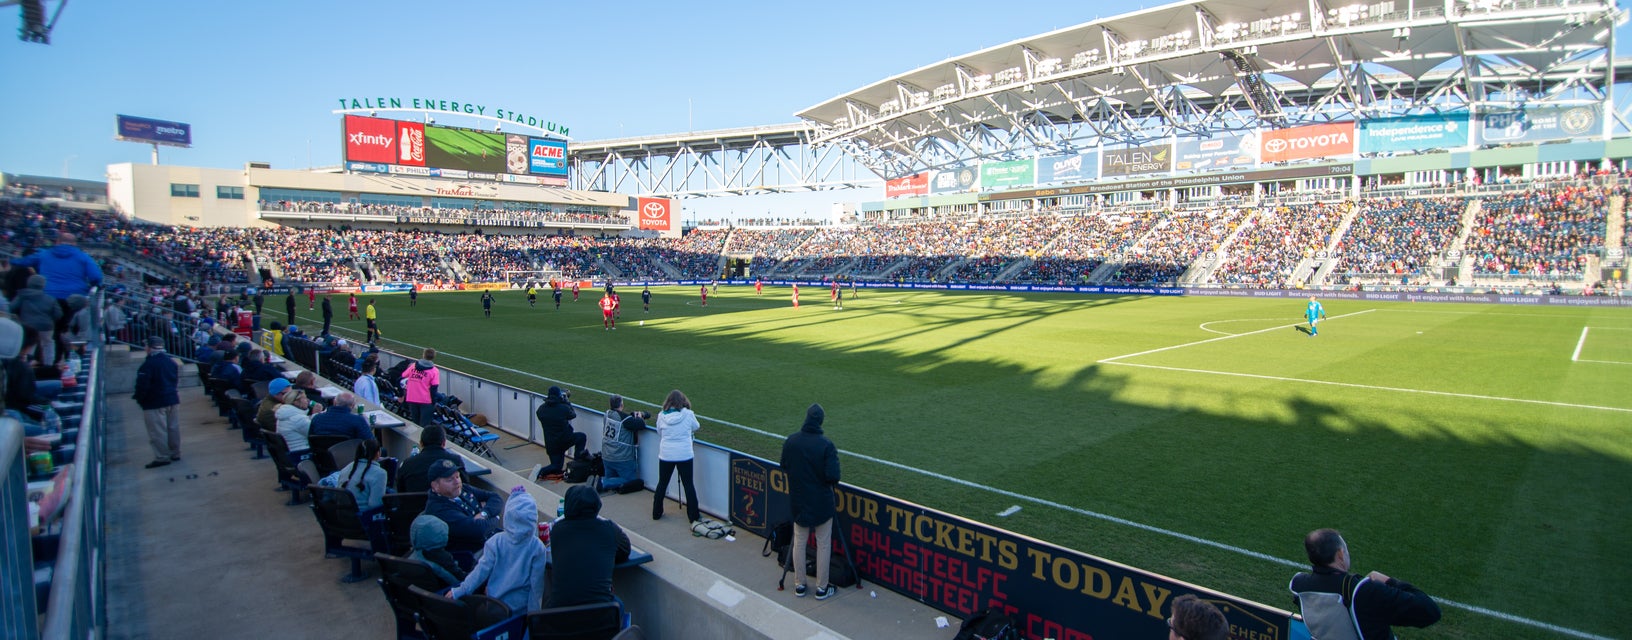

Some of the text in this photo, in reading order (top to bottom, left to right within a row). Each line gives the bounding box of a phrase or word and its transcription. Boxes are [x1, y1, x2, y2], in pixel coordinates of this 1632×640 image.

[339, 98, 569, 136] TALEN ENERGY STADIUM
[1370, 124, 1443, 136] Independence
[350, 132, 392, 148] xfinity
[1288, 133, 1348, 149] TOYOTA
[534, 146, 562, 157] ACME
[1106, 152, 1152, 166] TALEN
[1132, 163, 1165, 171] ENERGY
[436, 186, 474, 196] TruMark
[605, 426, 615, 439] 23
[736, 474, 764, 491] STEEL
[834, 488, 1172, 620] OUR TICKETS TODAY
[851, 524, 1008, 600] 844-STEELFC
